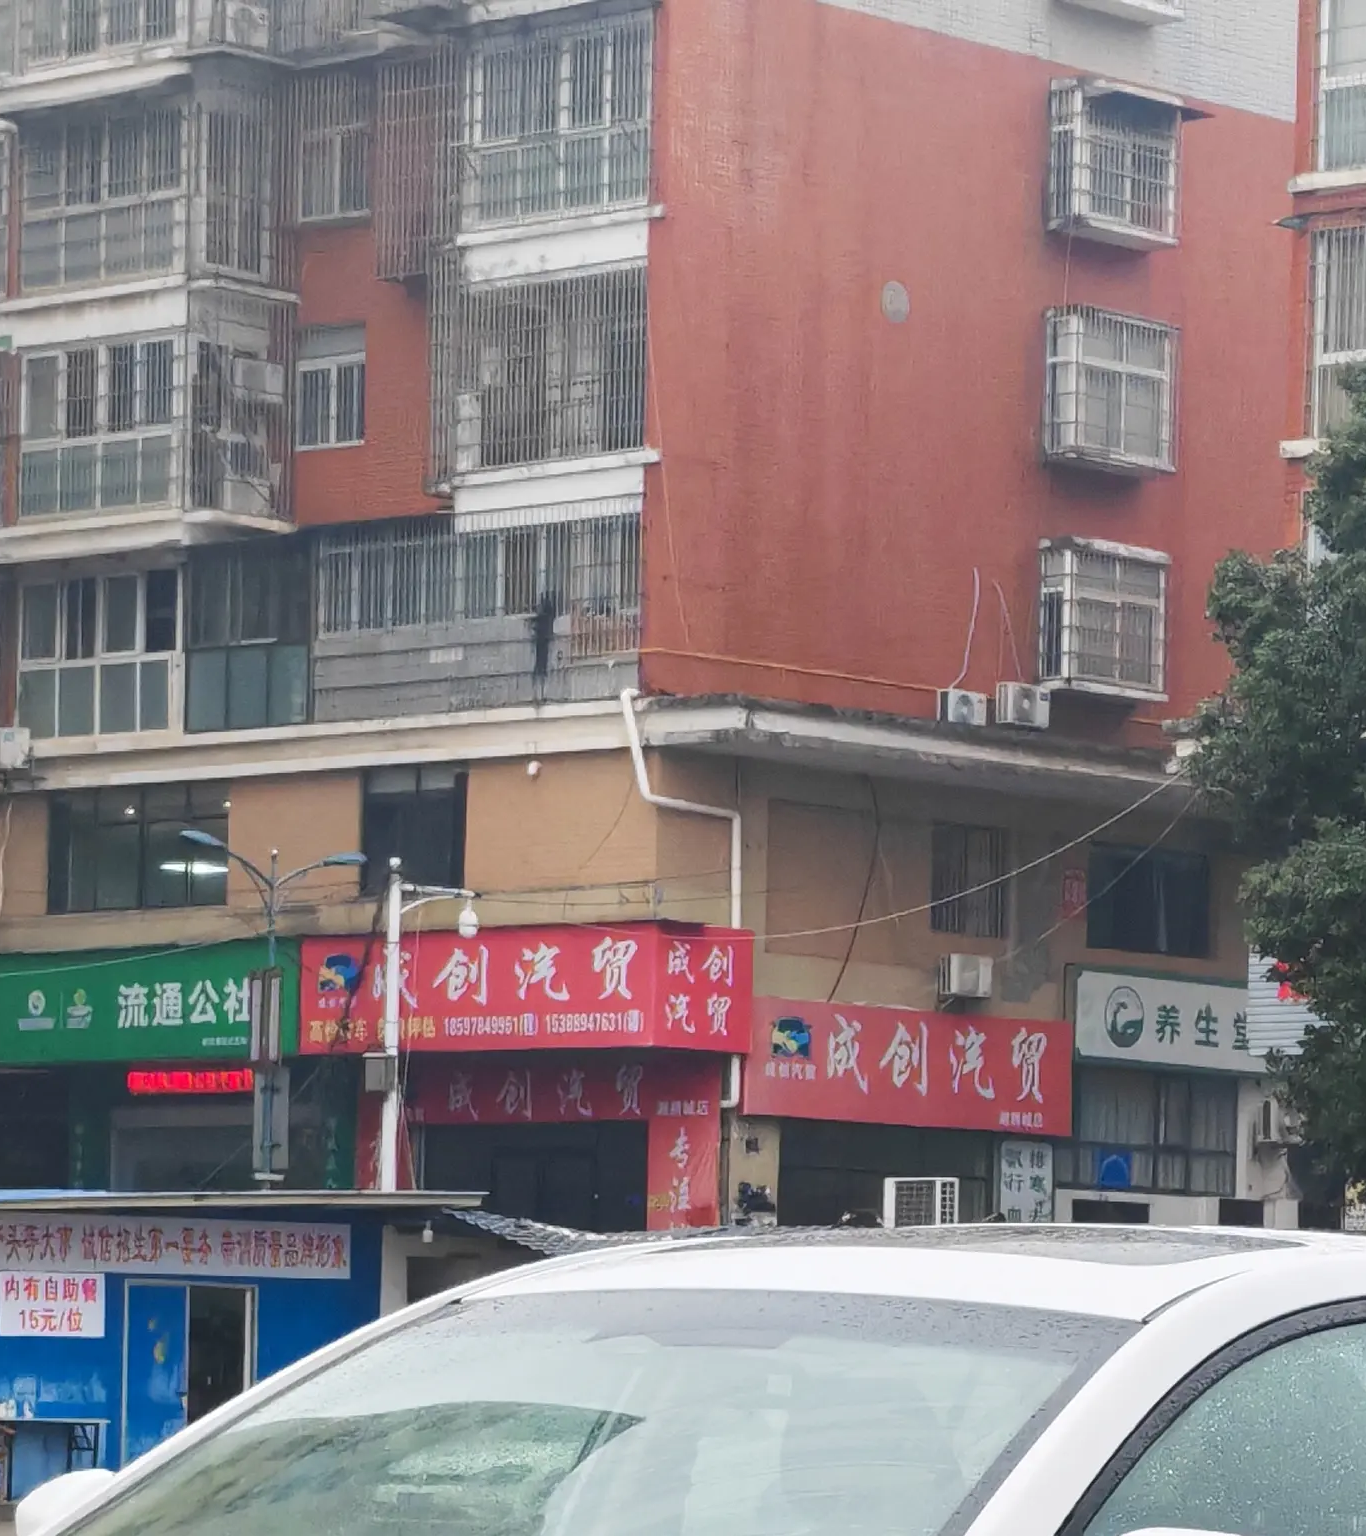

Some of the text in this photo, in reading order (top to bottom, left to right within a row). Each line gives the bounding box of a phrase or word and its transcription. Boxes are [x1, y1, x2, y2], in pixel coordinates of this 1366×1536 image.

[666, 941, 734, 988] 成创
[116, 977, 251, 1029] 流通公社
[664, 992, 732, 1036] 汽贸
[826, 1012, 1048, 1105] 成创汽贸
[667, 1125, 692, 1232] 专注
[5, 1274, 97, 1304] 内有自助餐
[19, 1307, 83, 1333] 15元/位
